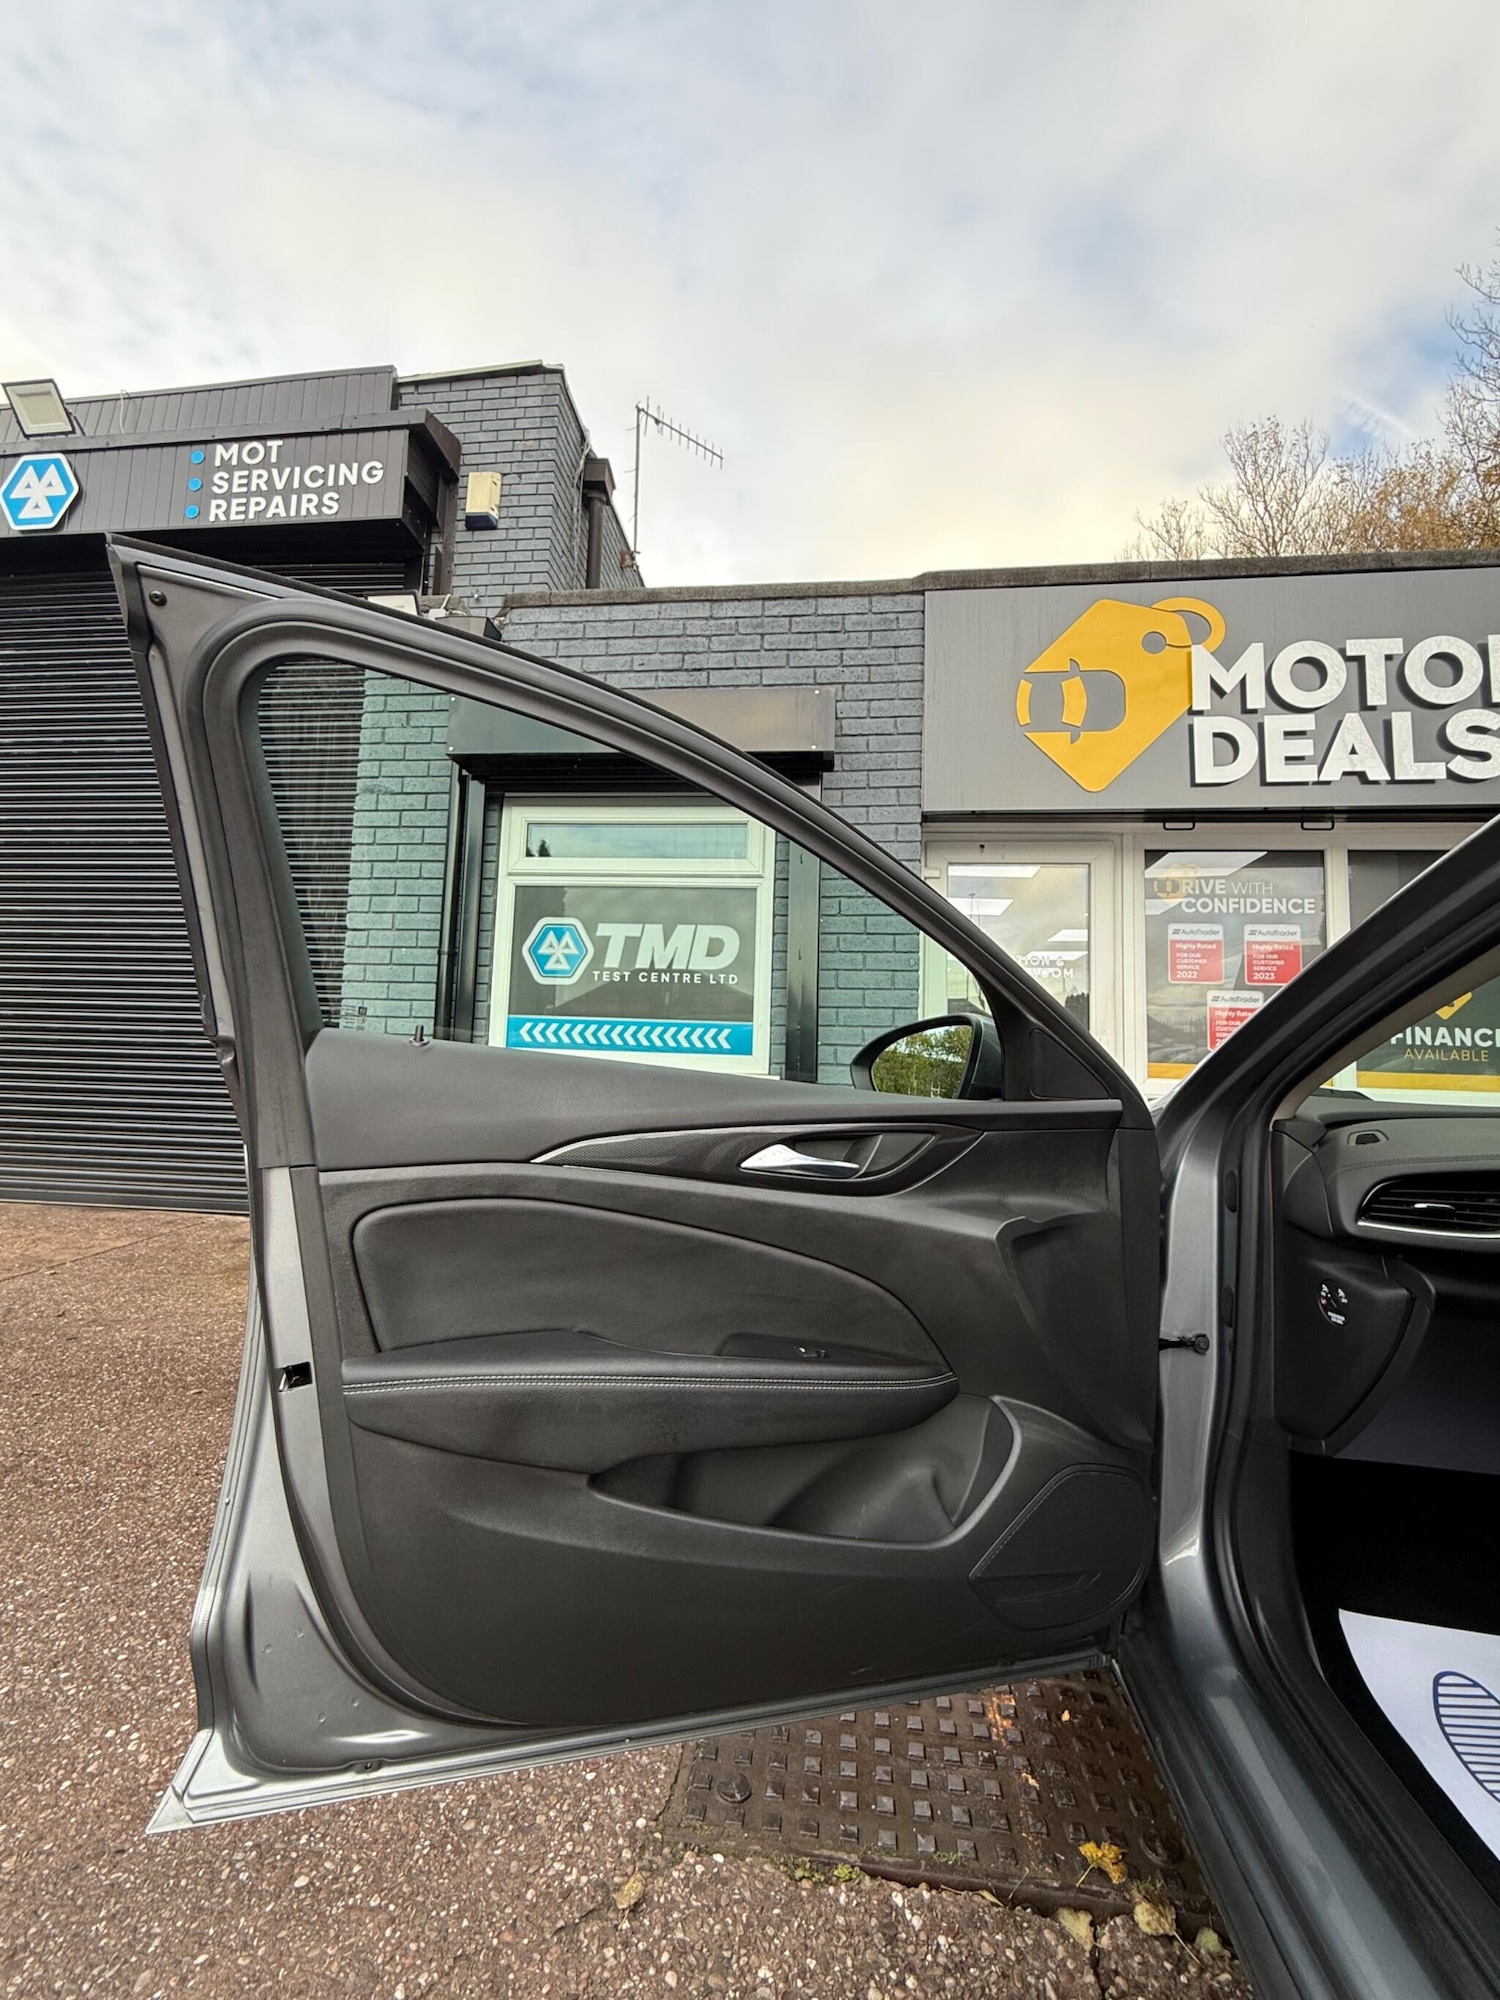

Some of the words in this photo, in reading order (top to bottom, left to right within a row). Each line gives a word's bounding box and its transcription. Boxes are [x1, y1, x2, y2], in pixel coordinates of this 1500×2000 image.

[214, 440, 284, 467] MOT
[211, 461, 385, 494] SERVICING
[208, 492, 341, 522] REPAIRS
[1191, 634, 1500, 712] MOTO
[1193, 708, 1500, 784] DEALS
[1230, 881, 1273, 895] WITH
[1181, 898, 1316, 914] CONFIDENCE
[595, 922, 741, 971] TMD
[592, 971, 631, 982] TEST
[638, 972, 702, 984] CENTRE
[709, 973, 738, 984] LTD
[1176, 970, 1198, 978] 2022
[1253, 972, 1276, 980] 2023
[1390, 1026, 1500, 1048] INANC
[1404, 1048, 1489, 1062] AVAILABLE
